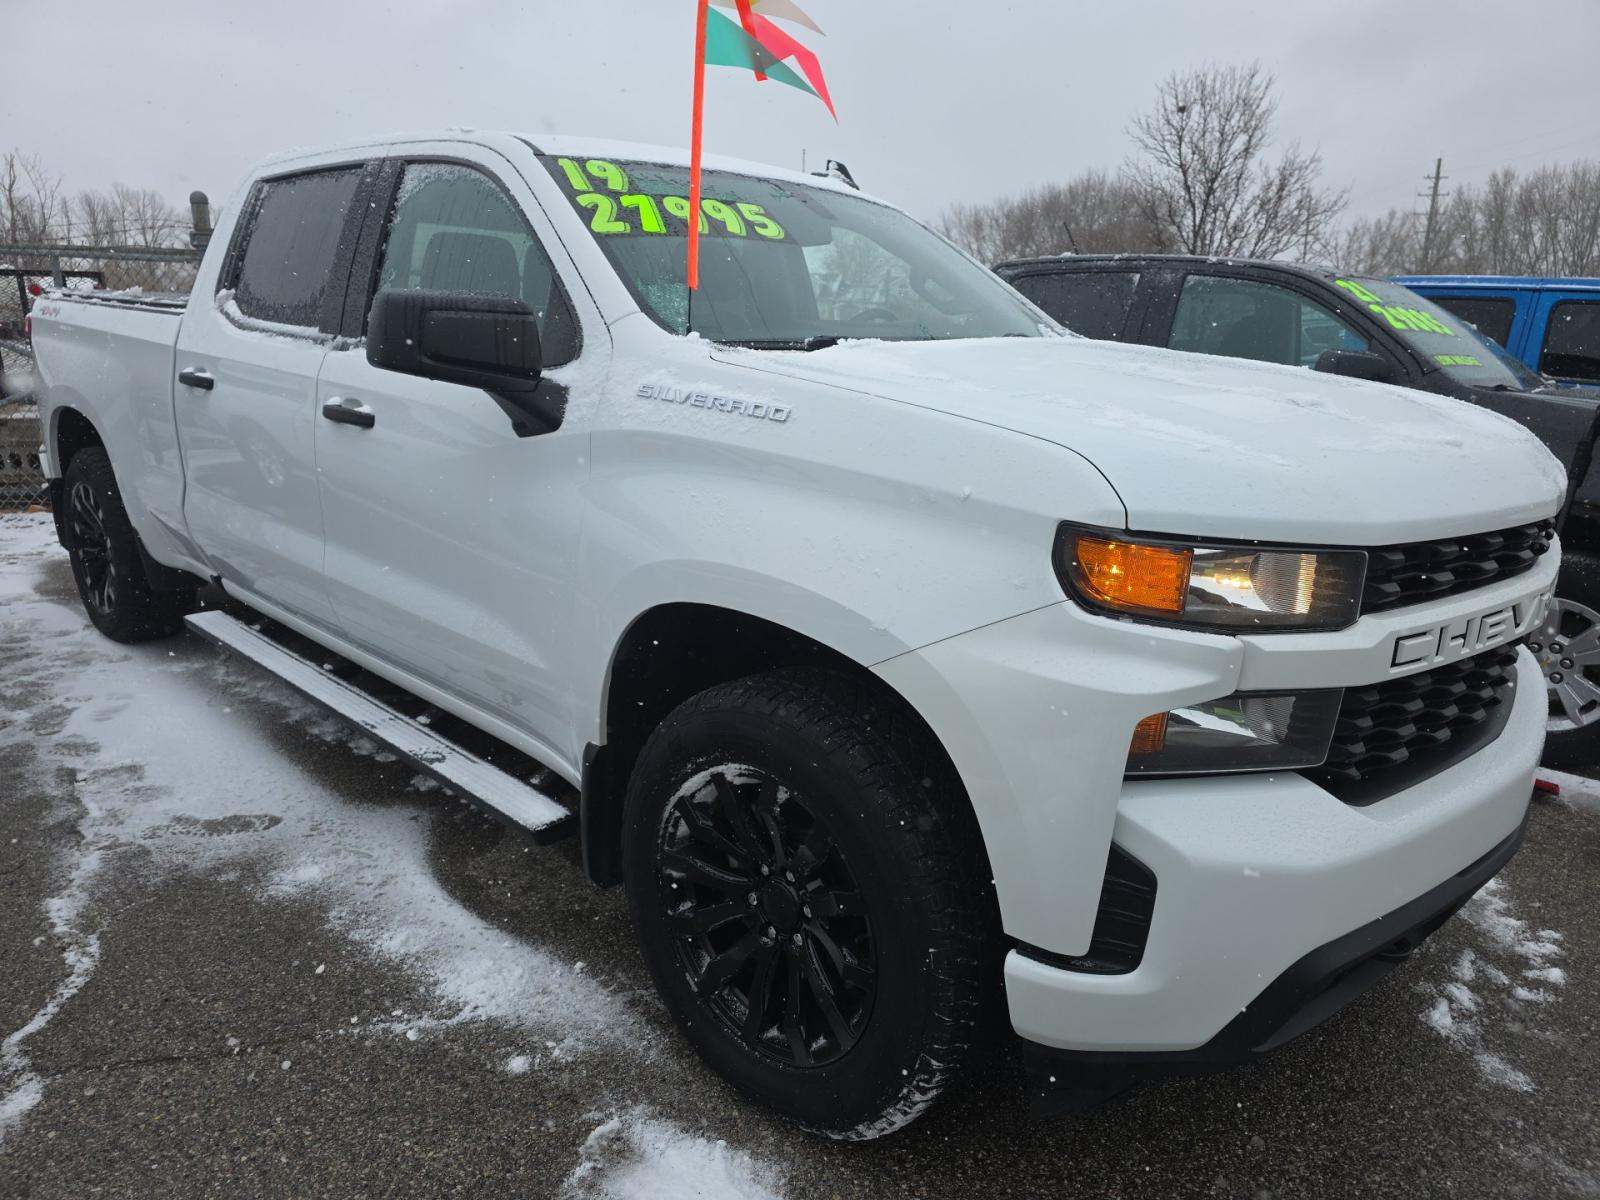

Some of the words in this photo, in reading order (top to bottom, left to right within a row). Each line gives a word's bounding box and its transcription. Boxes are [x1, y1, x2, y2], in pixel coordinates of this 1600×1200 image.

[558, 158, 629, 192] 19
[576, 193, 785, 240] 27995
[637, 384, 791, 422] SILVERADO
